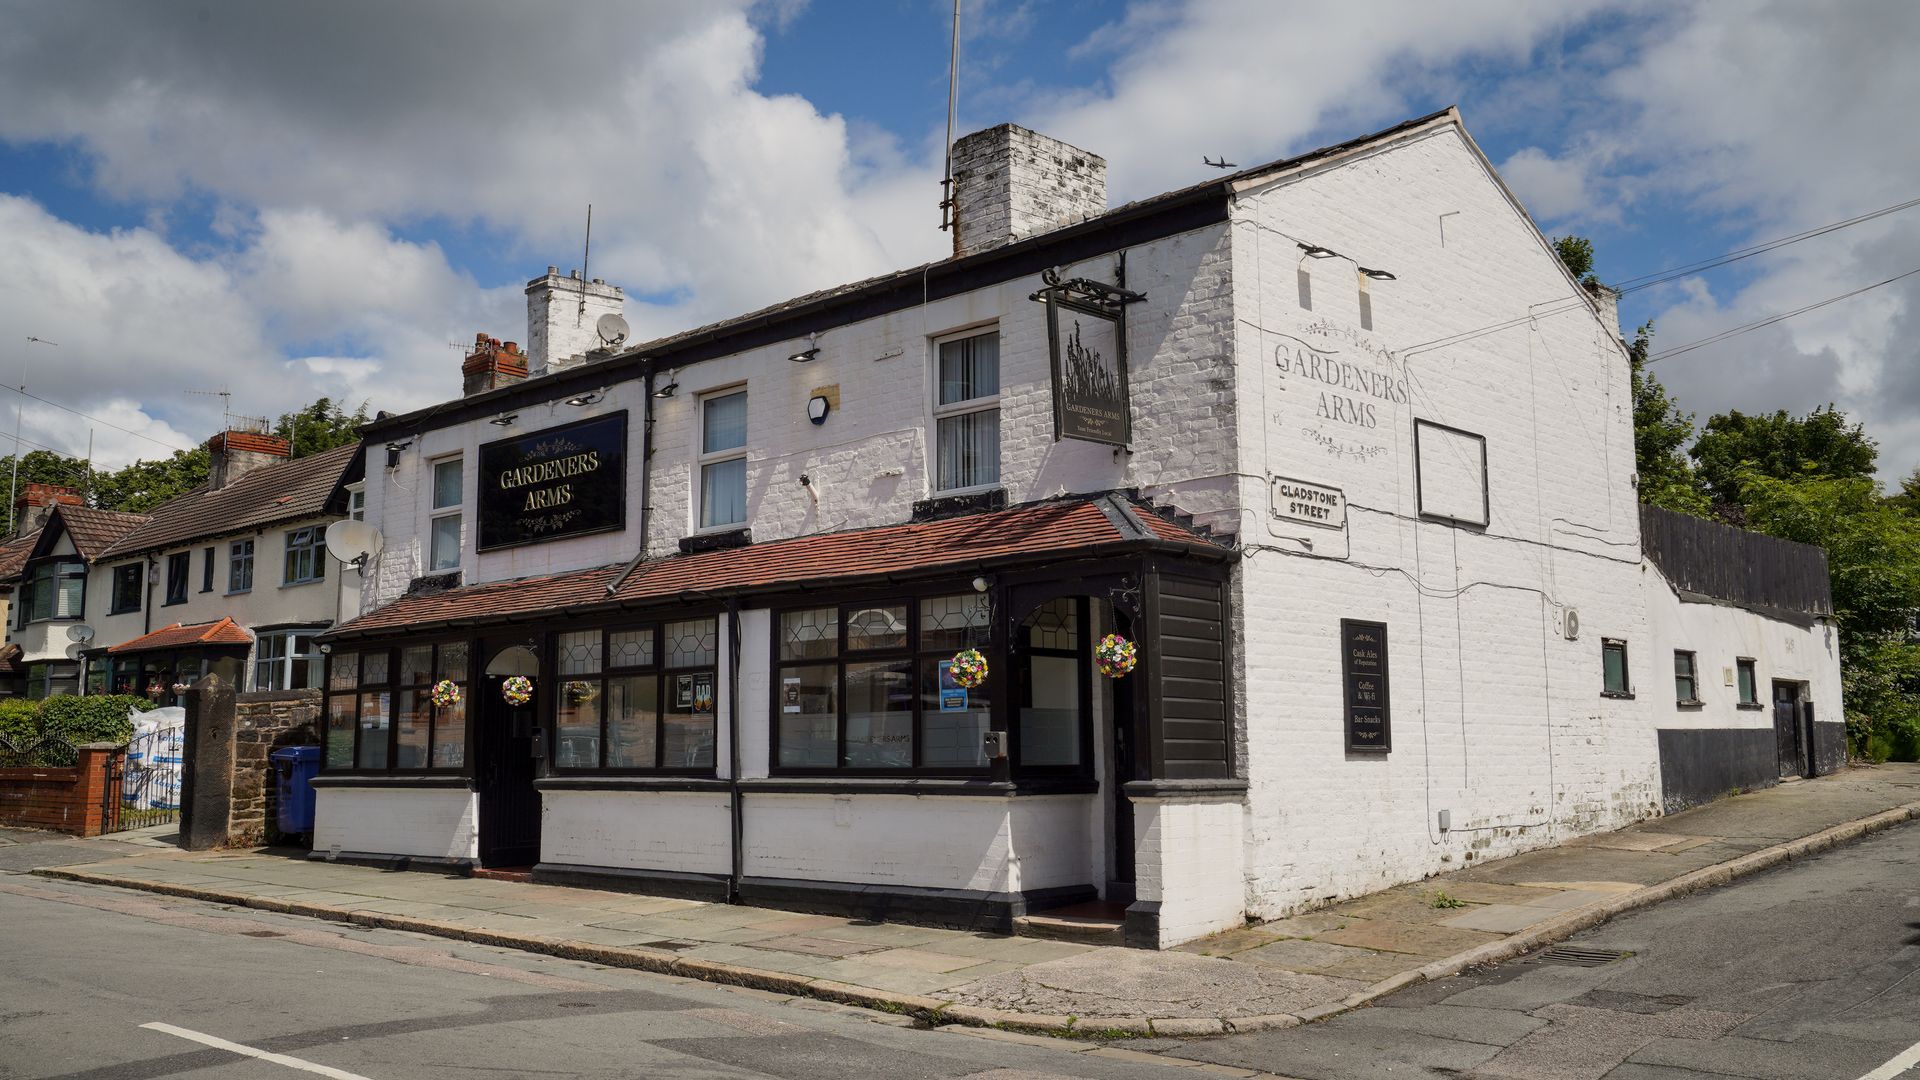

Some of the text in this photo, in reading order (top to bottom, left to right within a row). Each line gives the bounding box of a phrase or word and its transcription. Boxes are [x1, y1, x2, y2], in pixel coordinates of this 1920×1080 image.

[1275, 344, 1407, 404] GARDENERS
[1066, 403, 1120, 420] GARDENERS ARMS
[1316, 392, 1376, 429] ARMS
[501, 451, 599, 489] GARDENERS
[524, 484, 571, 511] ARMS
[1281, 485, 1337, 506] GLADSTONE
[1290, 502, 1330, 519] STREET
[1353, 649, 1377, 658] Cask Ales
[1358, 681, 1374, 690] Coffee
[1354, 715, 1381, 723] Bar Snacks
